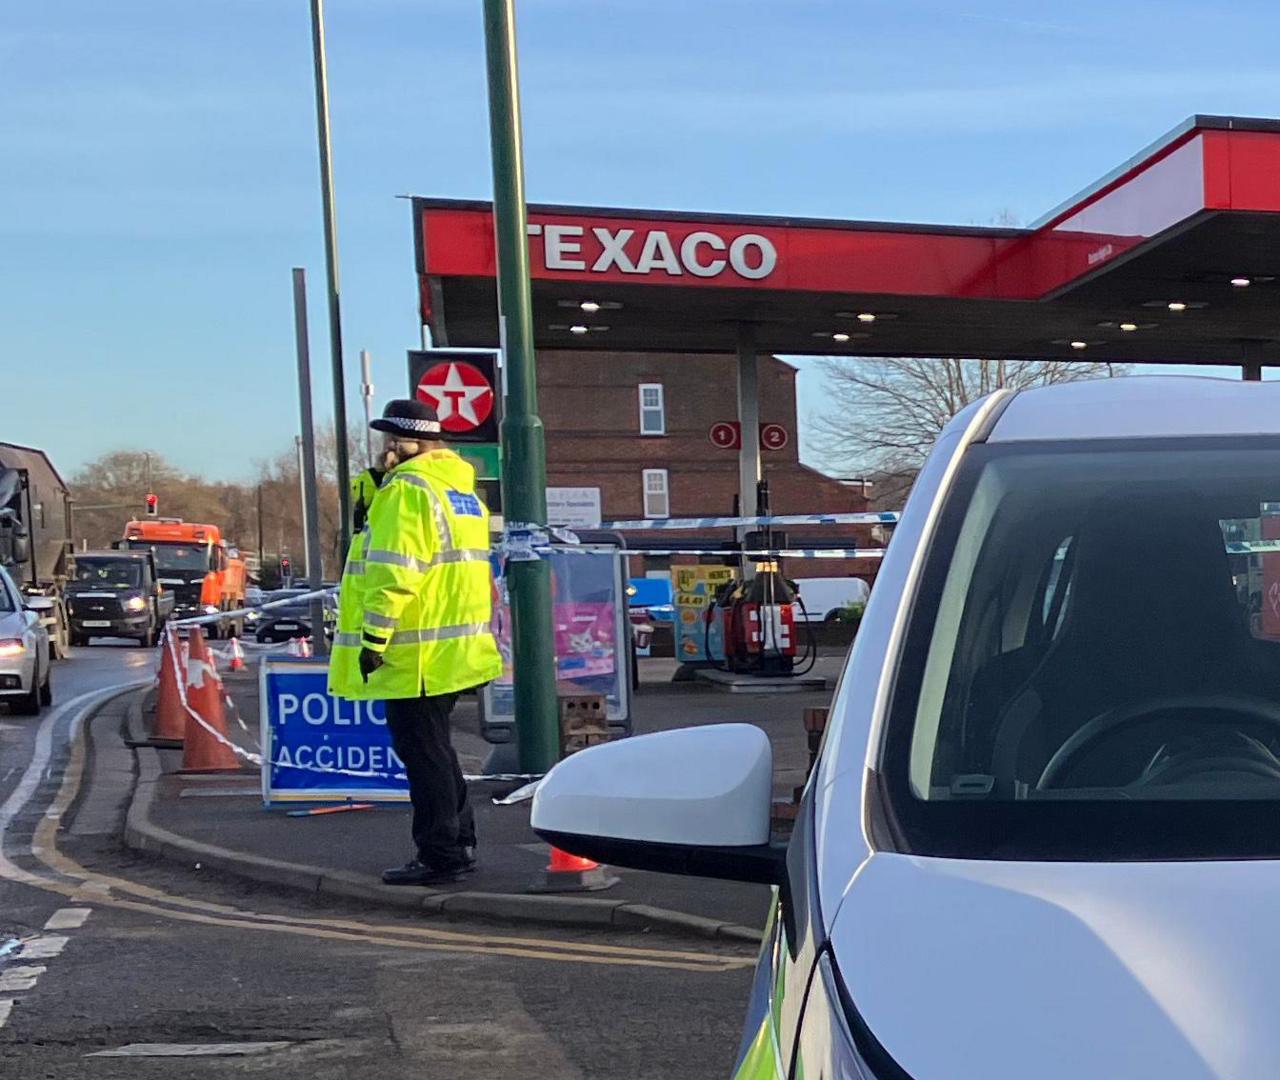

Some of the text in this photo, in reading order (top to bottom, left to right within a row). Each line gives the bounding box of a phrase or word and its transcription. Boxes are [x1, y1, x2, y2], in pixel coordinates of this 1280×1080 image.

[770, 431, 780, 442] 2
[278, 693, 388, 726] POLIC
[277, 745, 406, 769] ACCIDEN
